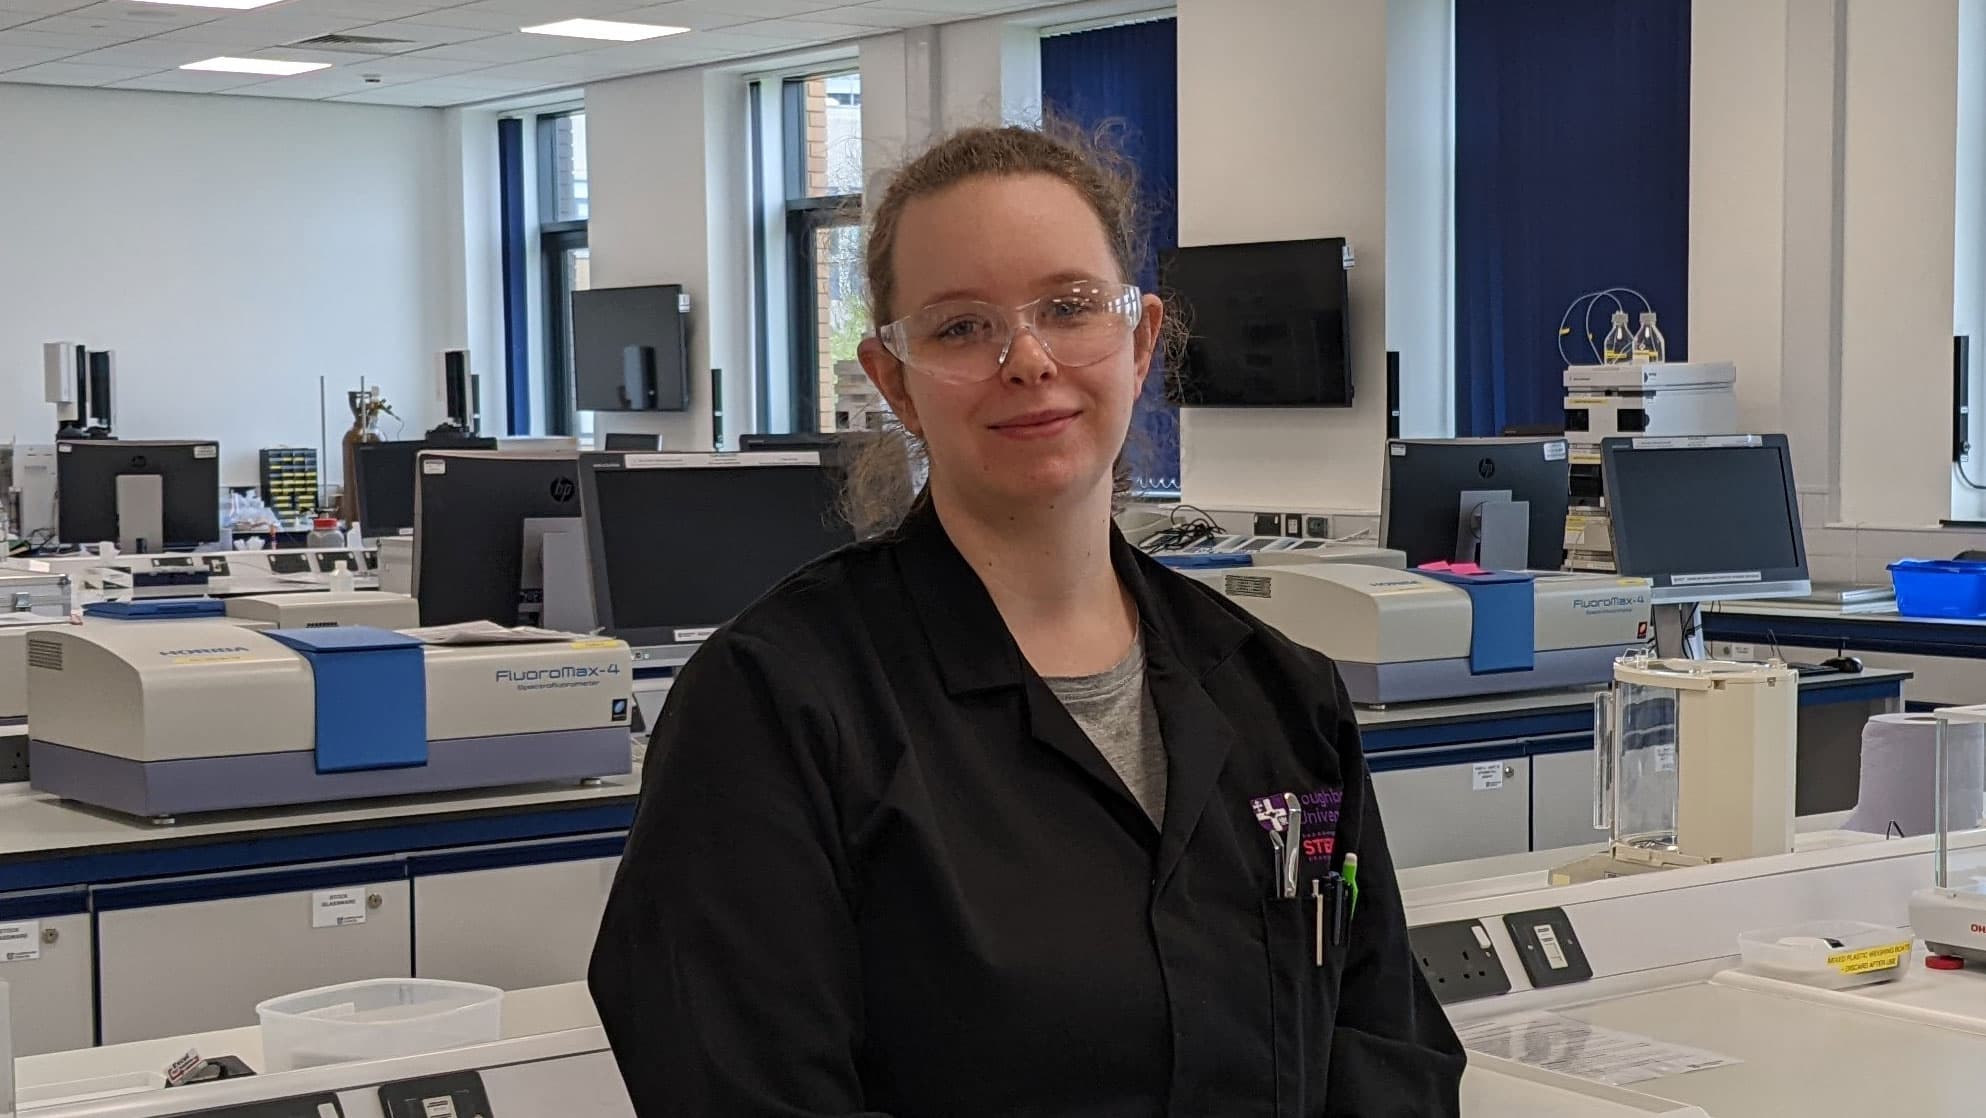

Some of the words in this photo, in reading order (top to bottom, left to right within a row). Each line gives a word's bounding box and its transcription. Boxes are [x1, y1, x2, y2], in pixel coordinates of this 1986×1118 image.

[551, 476, 575, 503] hp
[496, 663, 620, 682] FluoroMax-4
[1303, 837, 1335, 855] STE
[1970, 923, 1986, 934] OH
